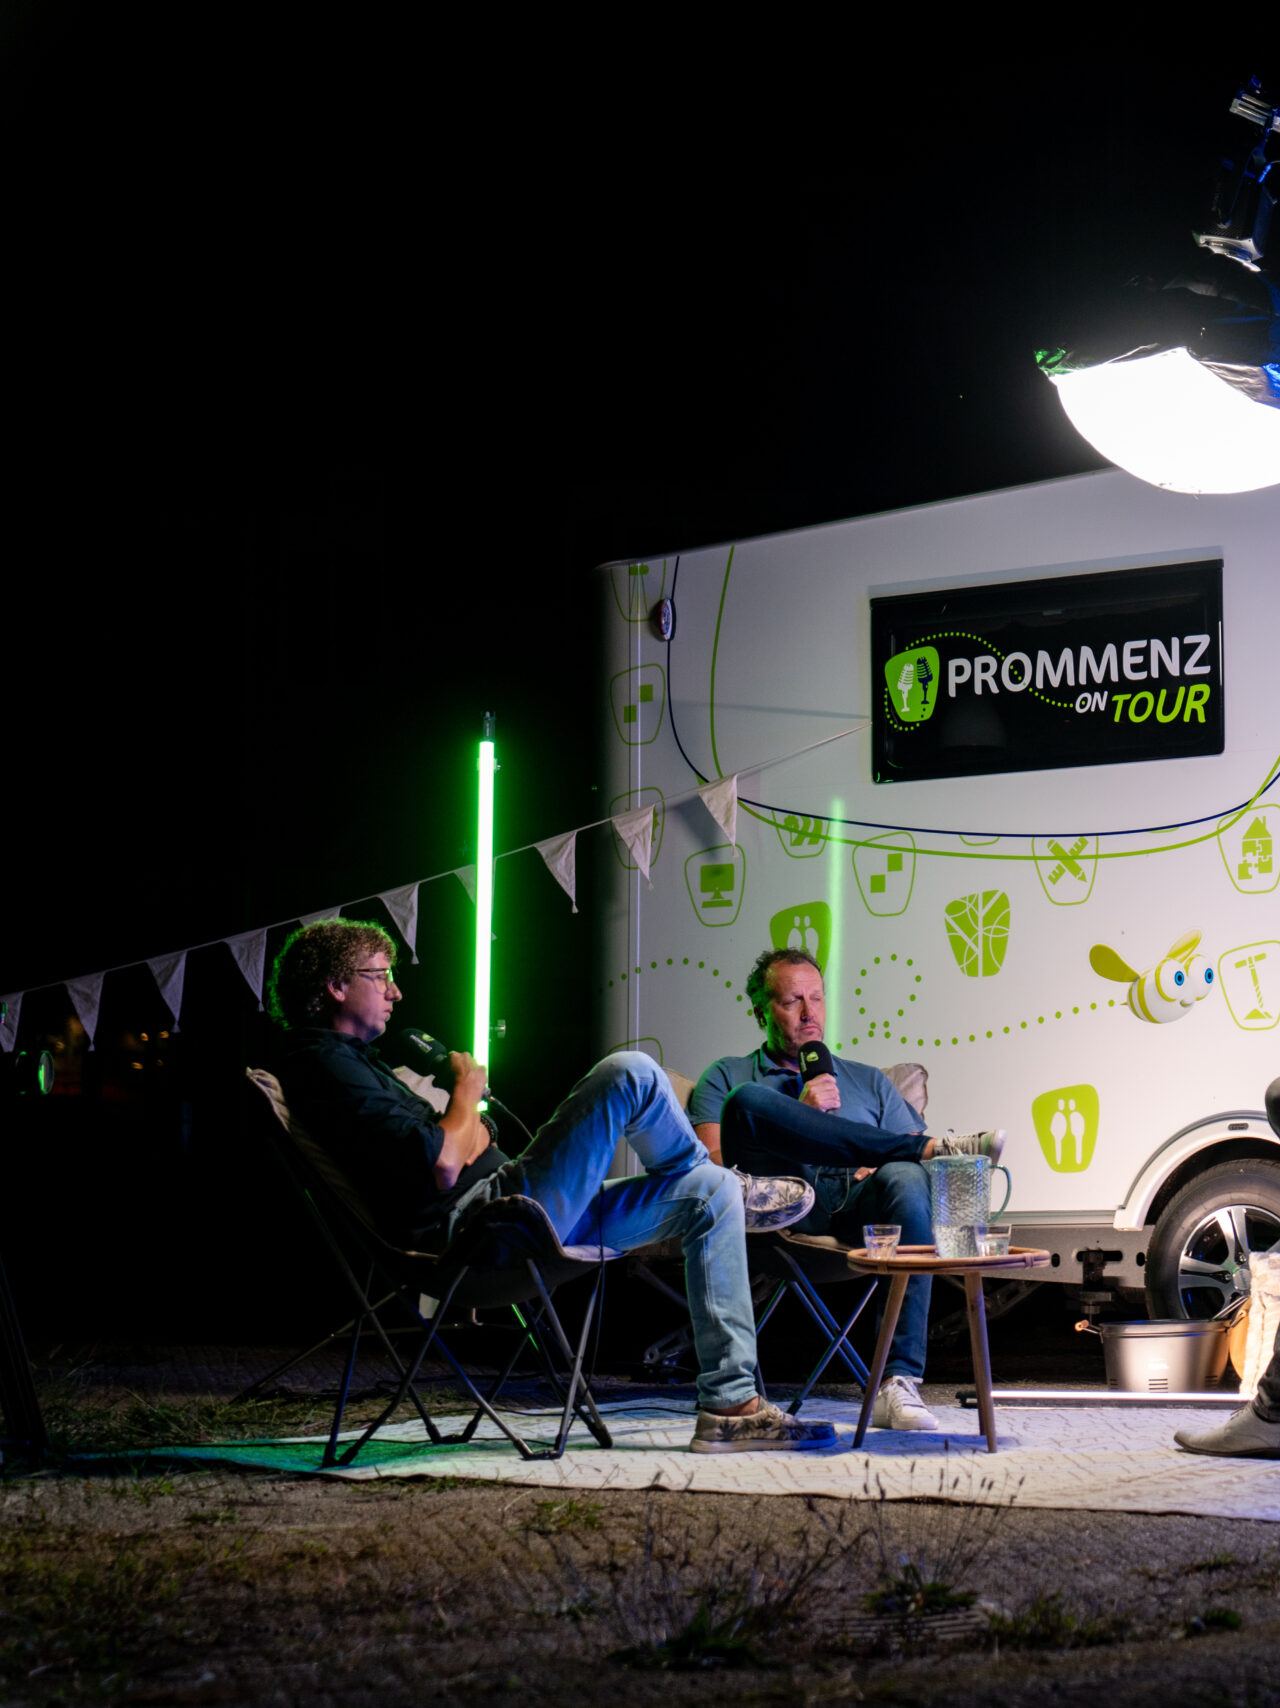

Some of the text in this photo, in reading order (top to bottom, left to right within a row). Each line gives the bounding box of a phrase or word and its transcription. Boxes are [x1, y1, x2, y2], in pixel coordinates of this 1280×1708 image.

[948, 633, 1211, 698] PROMMENZ
[1075, 683, 1211, 723] ON TOUR
